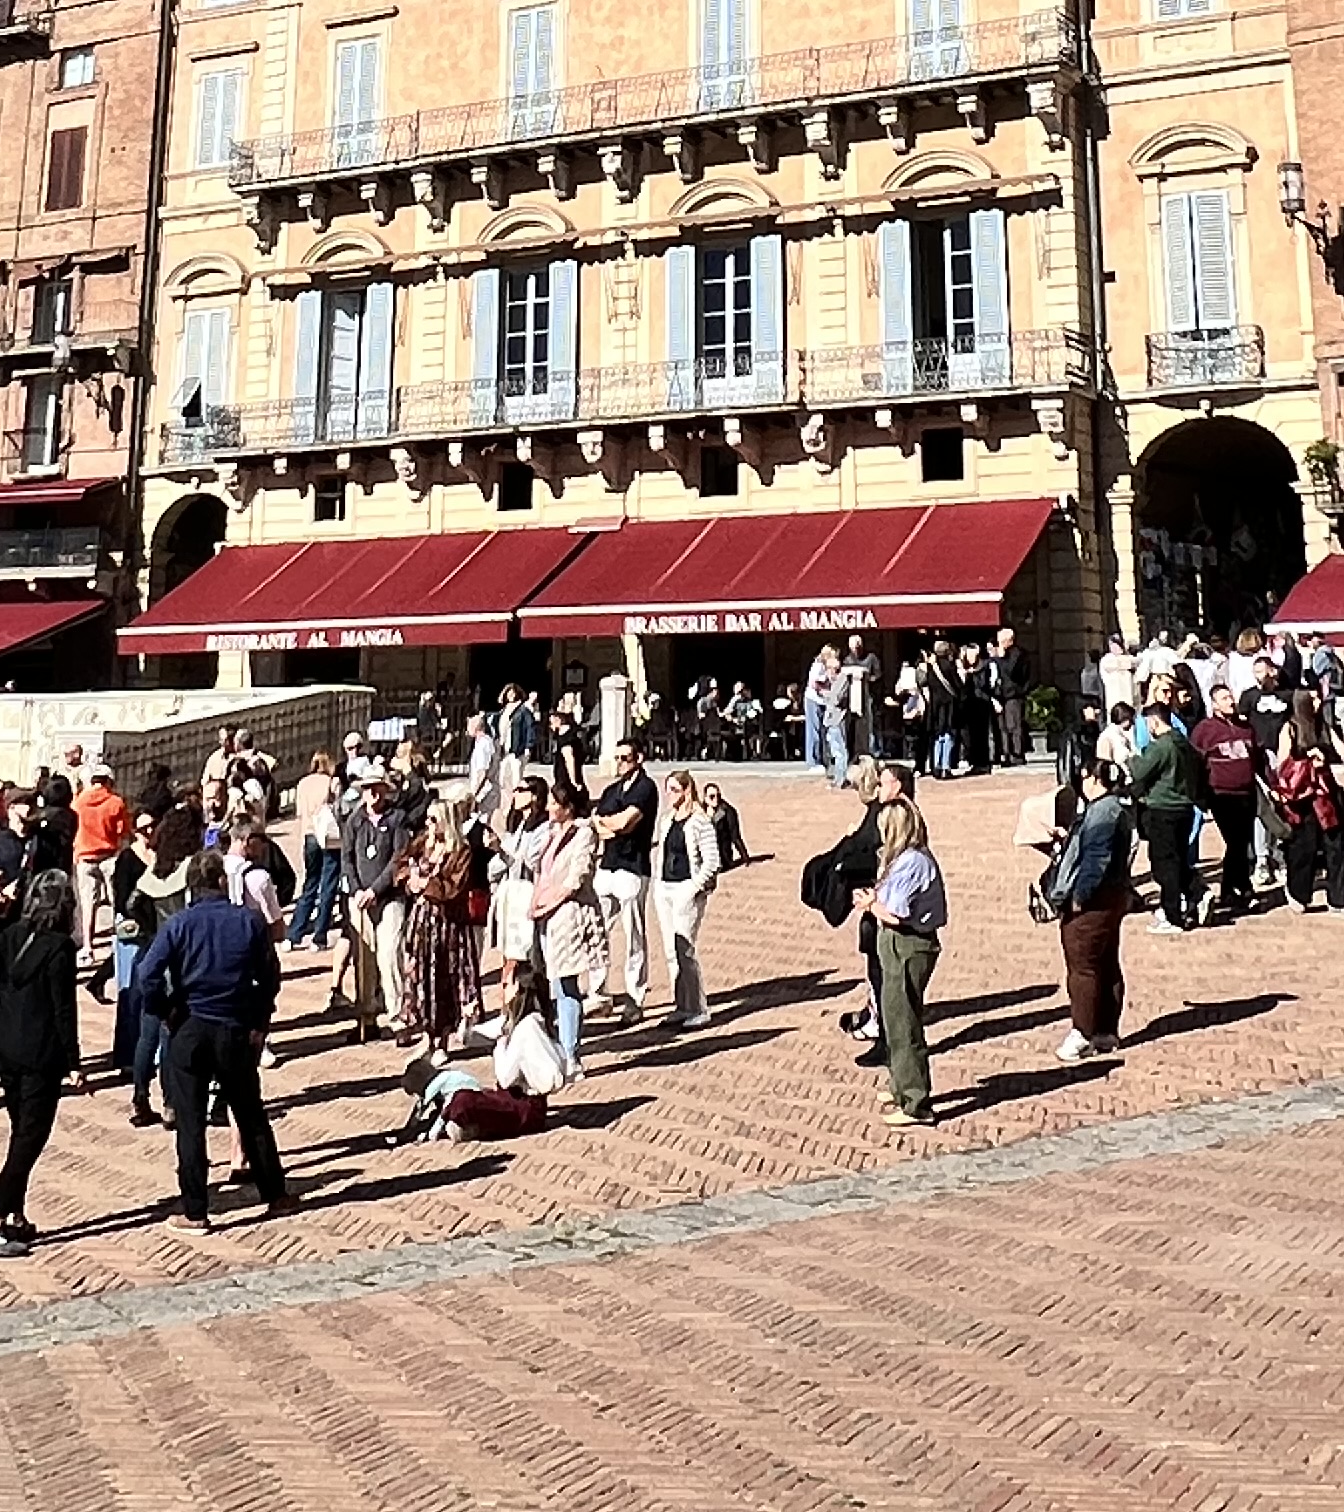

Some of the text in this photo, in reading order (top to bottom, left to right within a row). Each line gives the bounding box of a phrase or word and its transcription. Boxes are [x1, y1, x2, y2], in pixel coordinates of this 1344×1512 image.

[624, 609, 878, 635] BRASSERIE BAR AL MANGIA
[206, 628, 405, 650] RISTORANTE AL MANGIA
